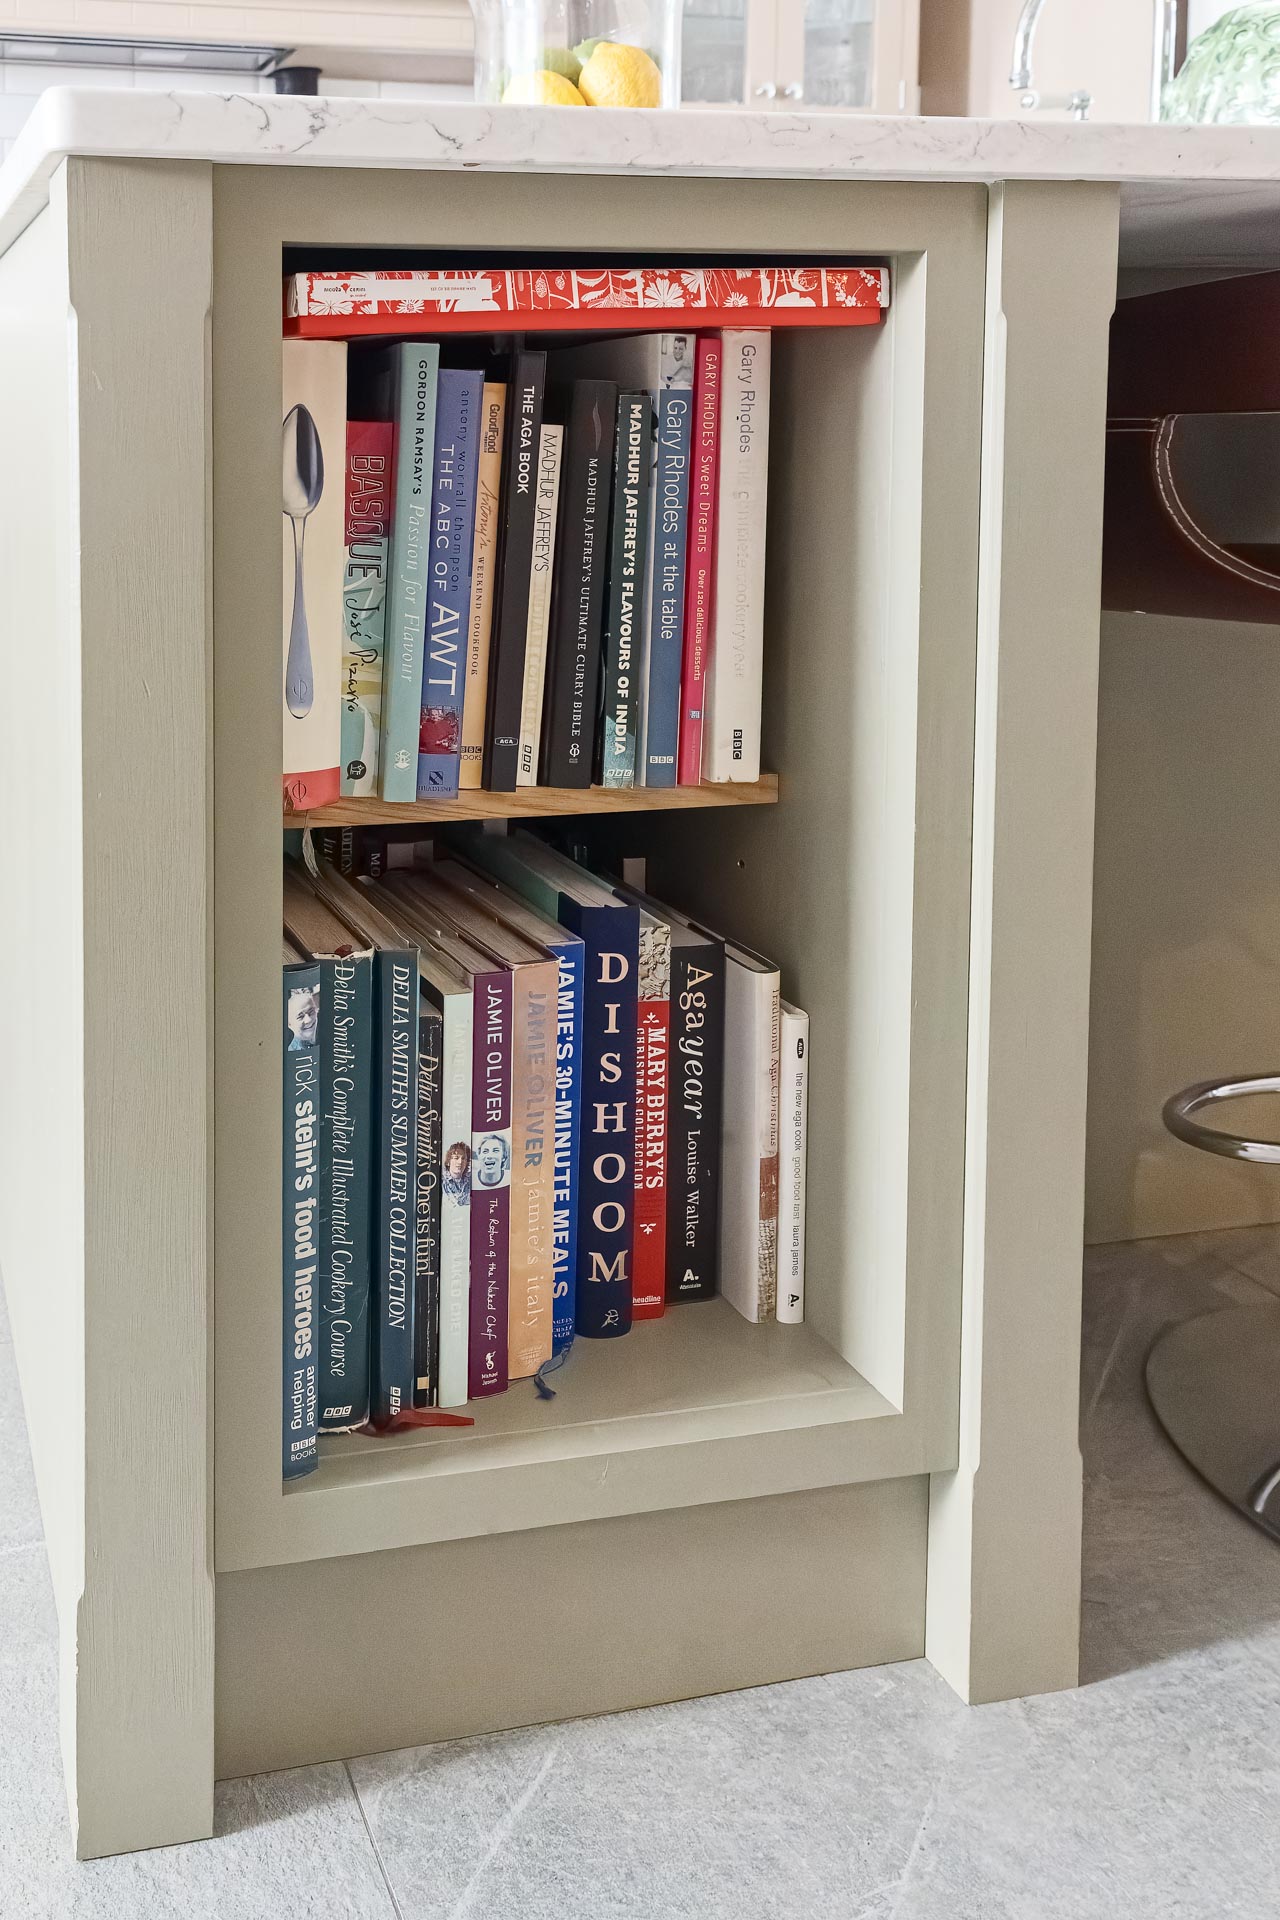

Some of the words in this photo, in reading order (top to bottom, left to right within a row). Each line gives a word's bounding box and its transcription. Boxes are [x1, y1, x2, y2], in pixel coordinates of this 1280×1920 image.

[416, 360, 428, 422] GORDON
[704, 353, 718, 388] GARY
[737, 344, 757, 385] Gary
[456, 390, 470, 444] antony
[522, 386, 535, 414] THE
[660, 399, 688, 450] Gary
[702, 393, 716, 450] RHODES'
[738, 390, 756, 454] Rhodes
[520, 417, 533, 448] AGA
[626, 404, 643, 485] MADHUR
[412, 428, 425, 496] RAMSAY'S
[438, 444, 454, 490] THE
[454, 451, 467, 508] worrall
[516, 452, 531, 494] BOOK
[539, 433, 558, 498] MADHUR
[586, 458, 599, 514] MADHUR
[699, 456, 713, 496] Sweet
[346, 455, 386, 579] BASQUE
[662, 455, 686, 534] Rhodes
[406, 503, 425, 570] Passion
[436, 502, 450, 549] ABC
[534, 505, 552, 572] JAFFREY'S
[581, 518, 594, 582] JAFFREY'S
[622, 489, 639, 576] JAFFREY'S
[664, 542, 679, 560] at
[697, 502, 711, 553] Dreams
[434, 561, 448, 592] OF
[450, 516, 465, 592] thompson
[662, 568, 680, 592] the
[698, 569, 706, 589] Over
[400, 574, 422, 604] for
[476, 556, 486, 610] WEEKEND
[696, 590, 704, 605] 120
[346, 598, 380, 642] José
[471, 616, 481, 676] COOKBOOK
[577, 587, 590, 650] ULTIMATE
[618, 582, 634, 670] FLAVOURS
[660, 598, 678, 640] table
[695, 607, 704, 644] delicious
[399, 612, 420, 682] Flavour
[428, 600, 460, 696] AWT
[694, 646, 702, 681] desserts
[346, 648, 378, 712] Pizarro
[574, 654, 586, 698] CURRY
[616, 676, 630, 698] OF
[572, 702, 583, 737] BIBLE
[614, 704, 628, 756] INDIA
[732, 729, 742, 760] BBC
[460, 746, 482, 754] BBC
[650, 756, 674, 764] BBC
[332, 964, 356, 1016] Delia
[392, 964, 410, 1026] DELIA
[486, 984, 503, 1045] JAMIE
[556, 954, 576, 1060] JAMIE'S
[679, 962, 714, 1032] Aga
[332, 1016, 356, 1073] Smith's
[528, 991, 547, 1065] JAMIE
[296, 1054, 317, 1096] rick
[391, 1028, 410, 1110] SMITH'S
[418, 1053, 438, 1102] Delia
[635, 1028, 645, 1104] CHRISTMAS
[646, 1026, 666, 1089] MARY
[678, 1036, 704, 1120] year
[795, 1072, 803, 1086] the
[324, 1076, 355, 1153] Complete
[486, 1052, 502, 1123] OLIVER
[795, 1088, 803, 1108] new
[417, 1104, 438, 1168] Smith's
[524, 1074, 546, 1169] OLIVER
[554, 1066, 574, 1202] 30-MINUTE
[588, 952, 629, 1282] DISHOOM
[645, 1093, 665, 1189] BERRY'S
[792, 1110, 802, 1128] aga
[794, 1130, 802, 1151] cook
[295, 1100, 317, 1192] stein's
[390, 1115, 409, 1203] SUMMER
[634, 1108, 644, 1190] COLLECTION
[686, 1129, 700, 1184] Louise
[331, 1157, 354, 1246] Illustrated
[416, 1170, 437, 1214] One
[488, 1198, 499, 1214] The
[684, 1189, 700, 1248] Walker
[294, 1198, 316, 1260] food
[416, 1217, 436, 1234] is
[488, 1218, 499, 1247] Return
[522, 1177, 545, 1265] jamie's
[792, 1225, 800, 1248] laura
[388, 1207, 407, 1330] COLLECTION
[416, 1238, 436, 1276] fun!
[487, 1262, 496, 1278] the
[552, 1209, 570, 1298] MEALS
[791, 1250, 800, 1276] james
[323, 1250, 354, 1316] Cookery
[486, 1280, 499, 1311] Naked
[522, 1275, 545, 1328] italy
[632, 1294, 661, 1304] headline
[294, 1264, 316, 1360] heroes
[480, 1316, 497, 1340] Chef
[330, 1318, 352, 1378] Course
[290, 1369, 304, 1430] helping
[306, 1365, 316, 1428] another
[322, 1405, 352, 1418] BBC
[390, 1386, 400, 1416] BBC
[290, 1447, 316, 1462] BOOKS
[291, 1435, 316, 1452] BBC
